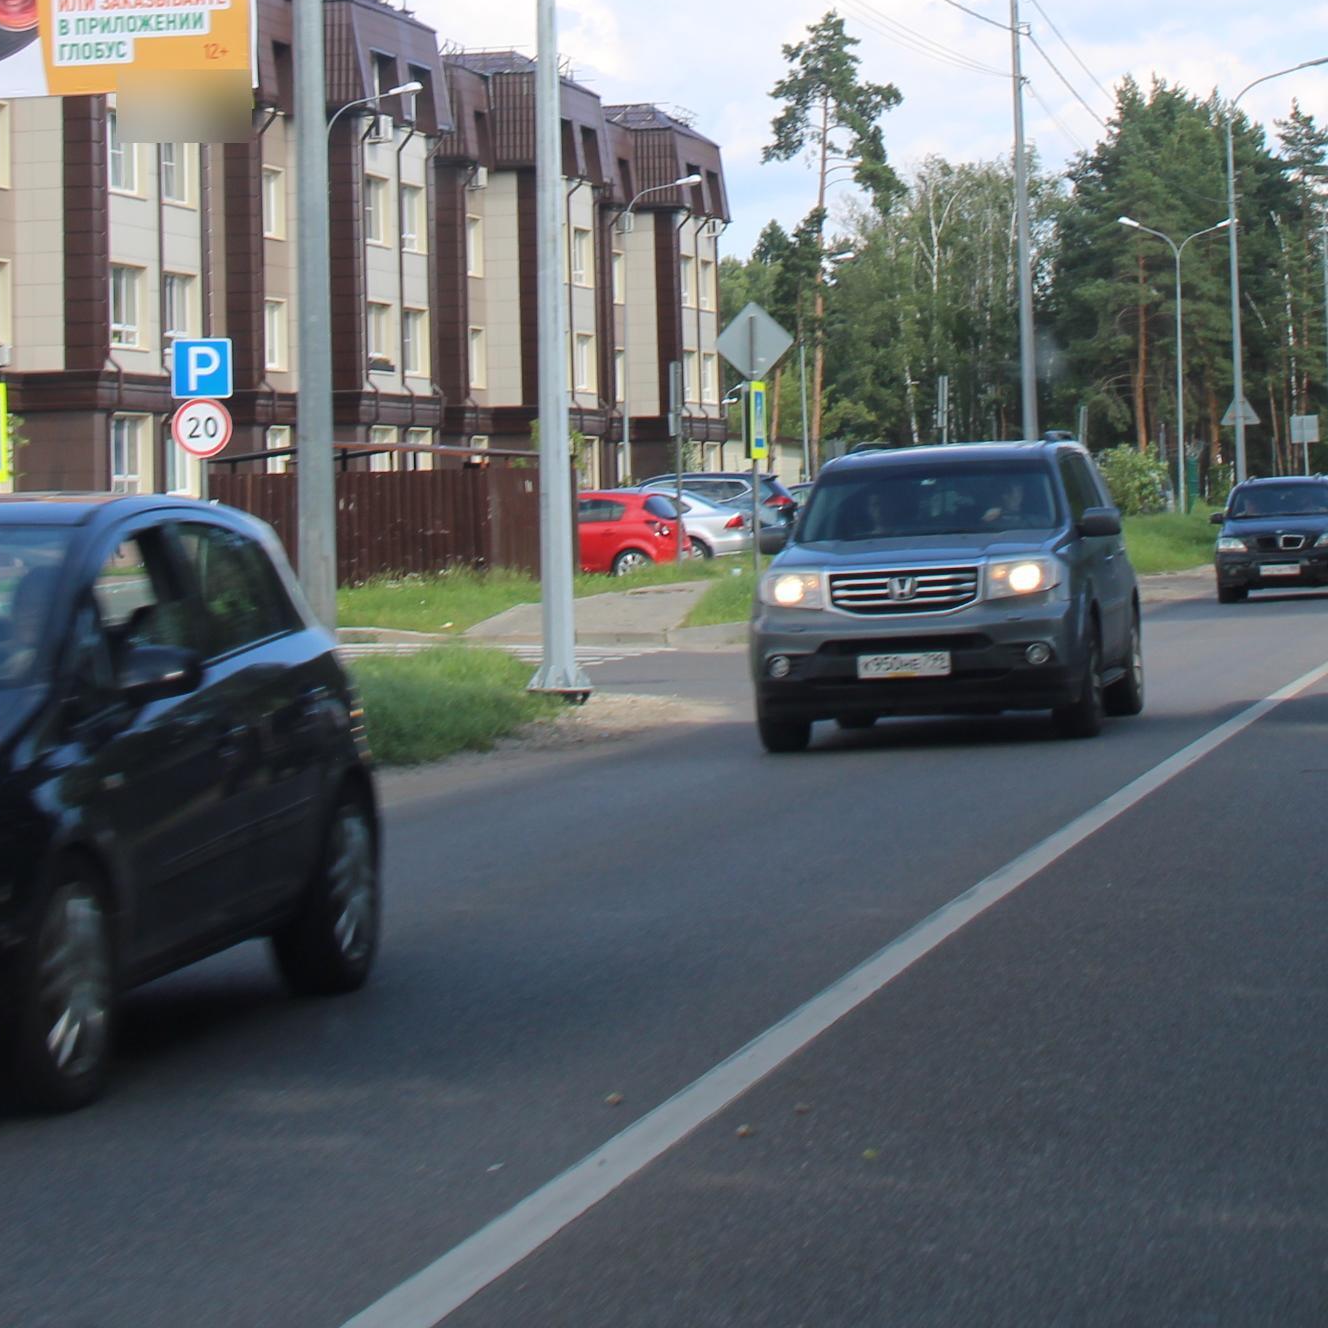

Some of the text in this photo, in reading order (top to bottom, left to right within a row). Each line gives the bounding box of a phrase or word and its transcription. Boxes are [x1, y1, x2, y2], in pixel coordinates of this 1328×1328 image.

[58, 12, 204, 36] В ПРИЛОЖЕНИИ
[58, 41, 128, 61] ГЛОБУС
[203, 43, 229, 60] 12+
[186, 416, 218, 439] 20
